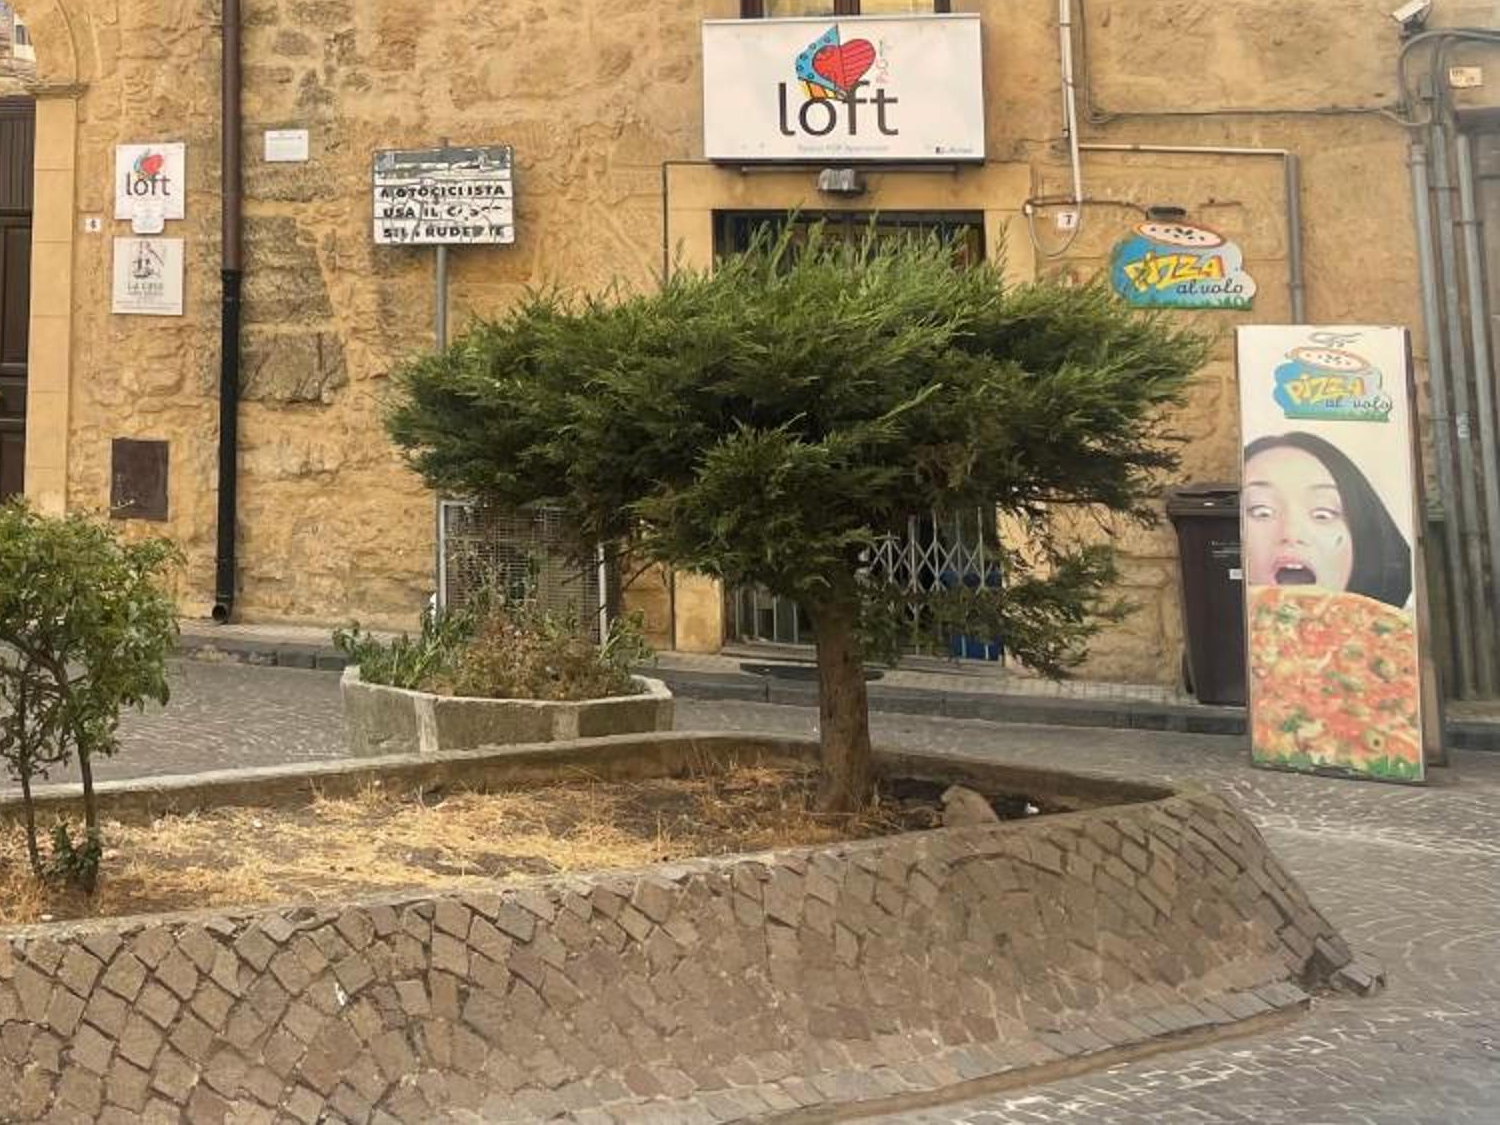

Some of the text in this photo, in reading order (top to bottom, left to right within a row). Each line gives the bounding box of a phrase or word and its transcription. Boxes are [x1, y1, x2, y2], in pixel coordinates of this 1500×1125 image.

[778, 79, 899, 136] loft
[126, 171, 171, 196] loft
[383, 207, 415, 219] USA
[424, 208, 439, 218] IL
[1175, 277, 1244, 295] al volo
